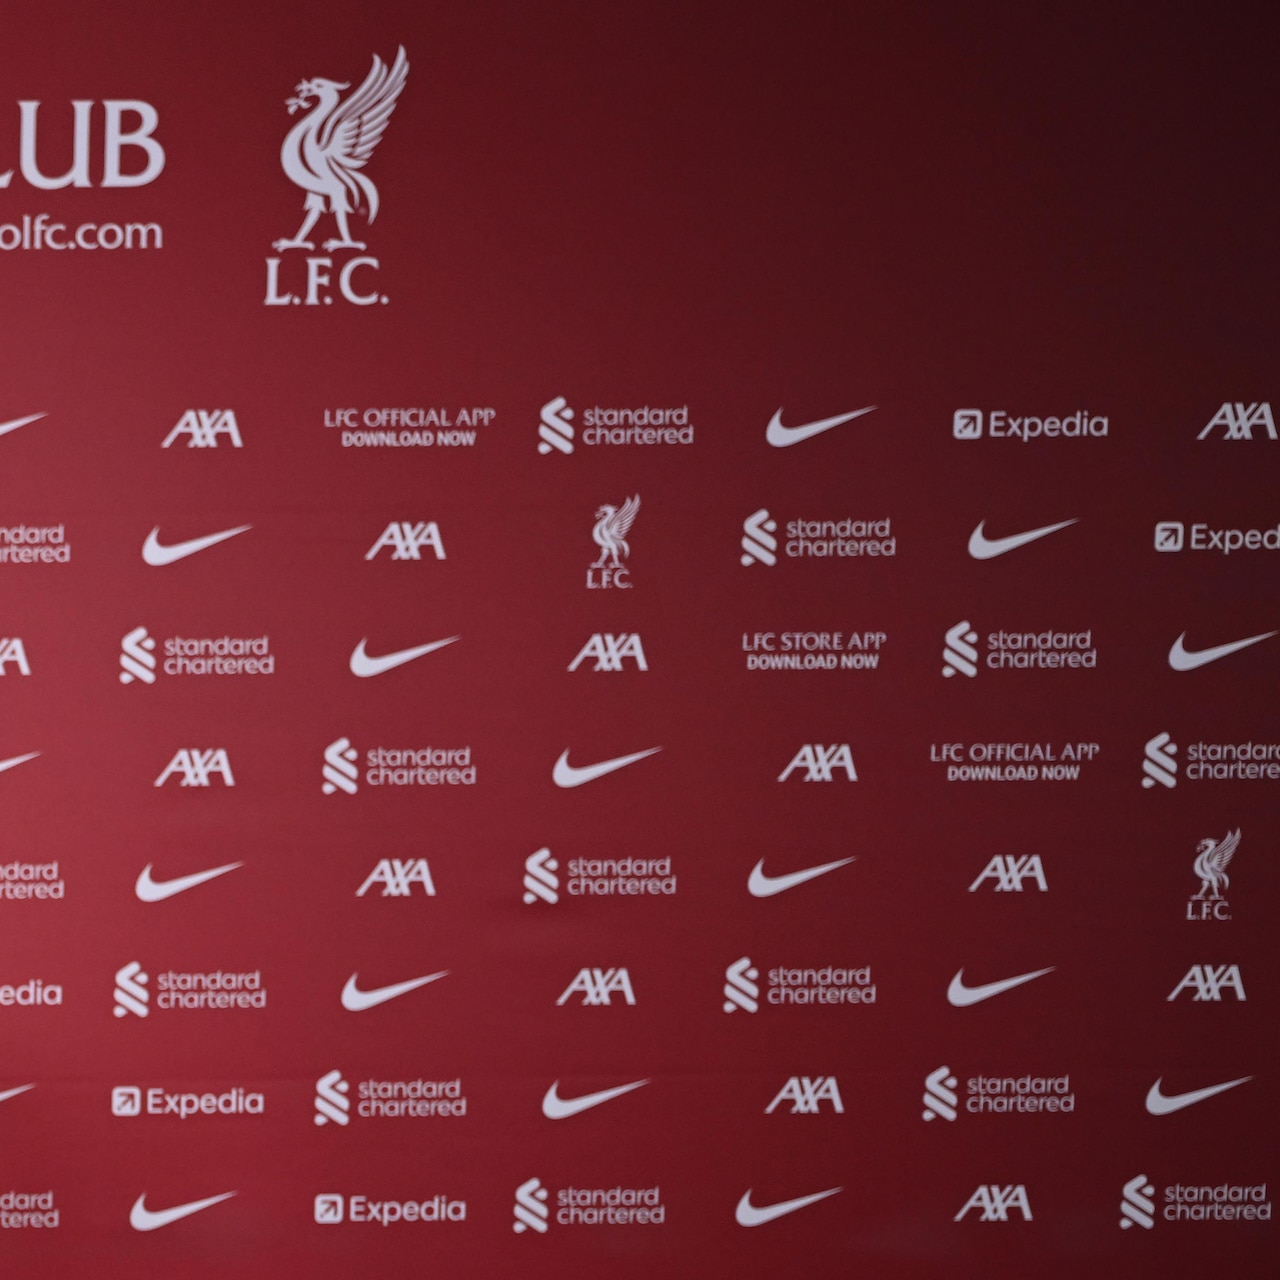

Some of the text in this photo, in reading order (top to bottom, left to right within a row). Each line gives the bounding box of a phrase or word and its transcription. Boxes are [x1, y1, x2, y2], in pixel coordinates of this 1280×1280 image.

[263, 257, 390, 306] L.F.C.
[323, 407, 497, 428] LFC OFFICIAL APP
[583, 405, 689, 426] standard
[161, 409, 243, 449] AXA
[582, 425, 695, 446] chartered
[988, 410, 1109, 443] Expedia
[341, 429, 477, 448] DOWNLOAD NOW
[567, 633, 648, 672] AXA
[366, 746, 471, 766] standard
[930, 742, 1100, 762] LFC OFFICIAL APP
[777, 743, 858, 783] AXA
[946, 764, 1081, 782] DOWNLOAD NOW
[365, 765, 477, 786] chartered
[355, 858, 436, 897] AXA
[1166, 964, 1247, 1002] AXA
[966, 1074, 1069, 1094] standard
[765, 1076, 844, 1114] AXA
[965, 1093, 1075, 1113] chartered
[557, 1186, 660, 1206] standard
[556, 1205, 666, 1225] chartered
